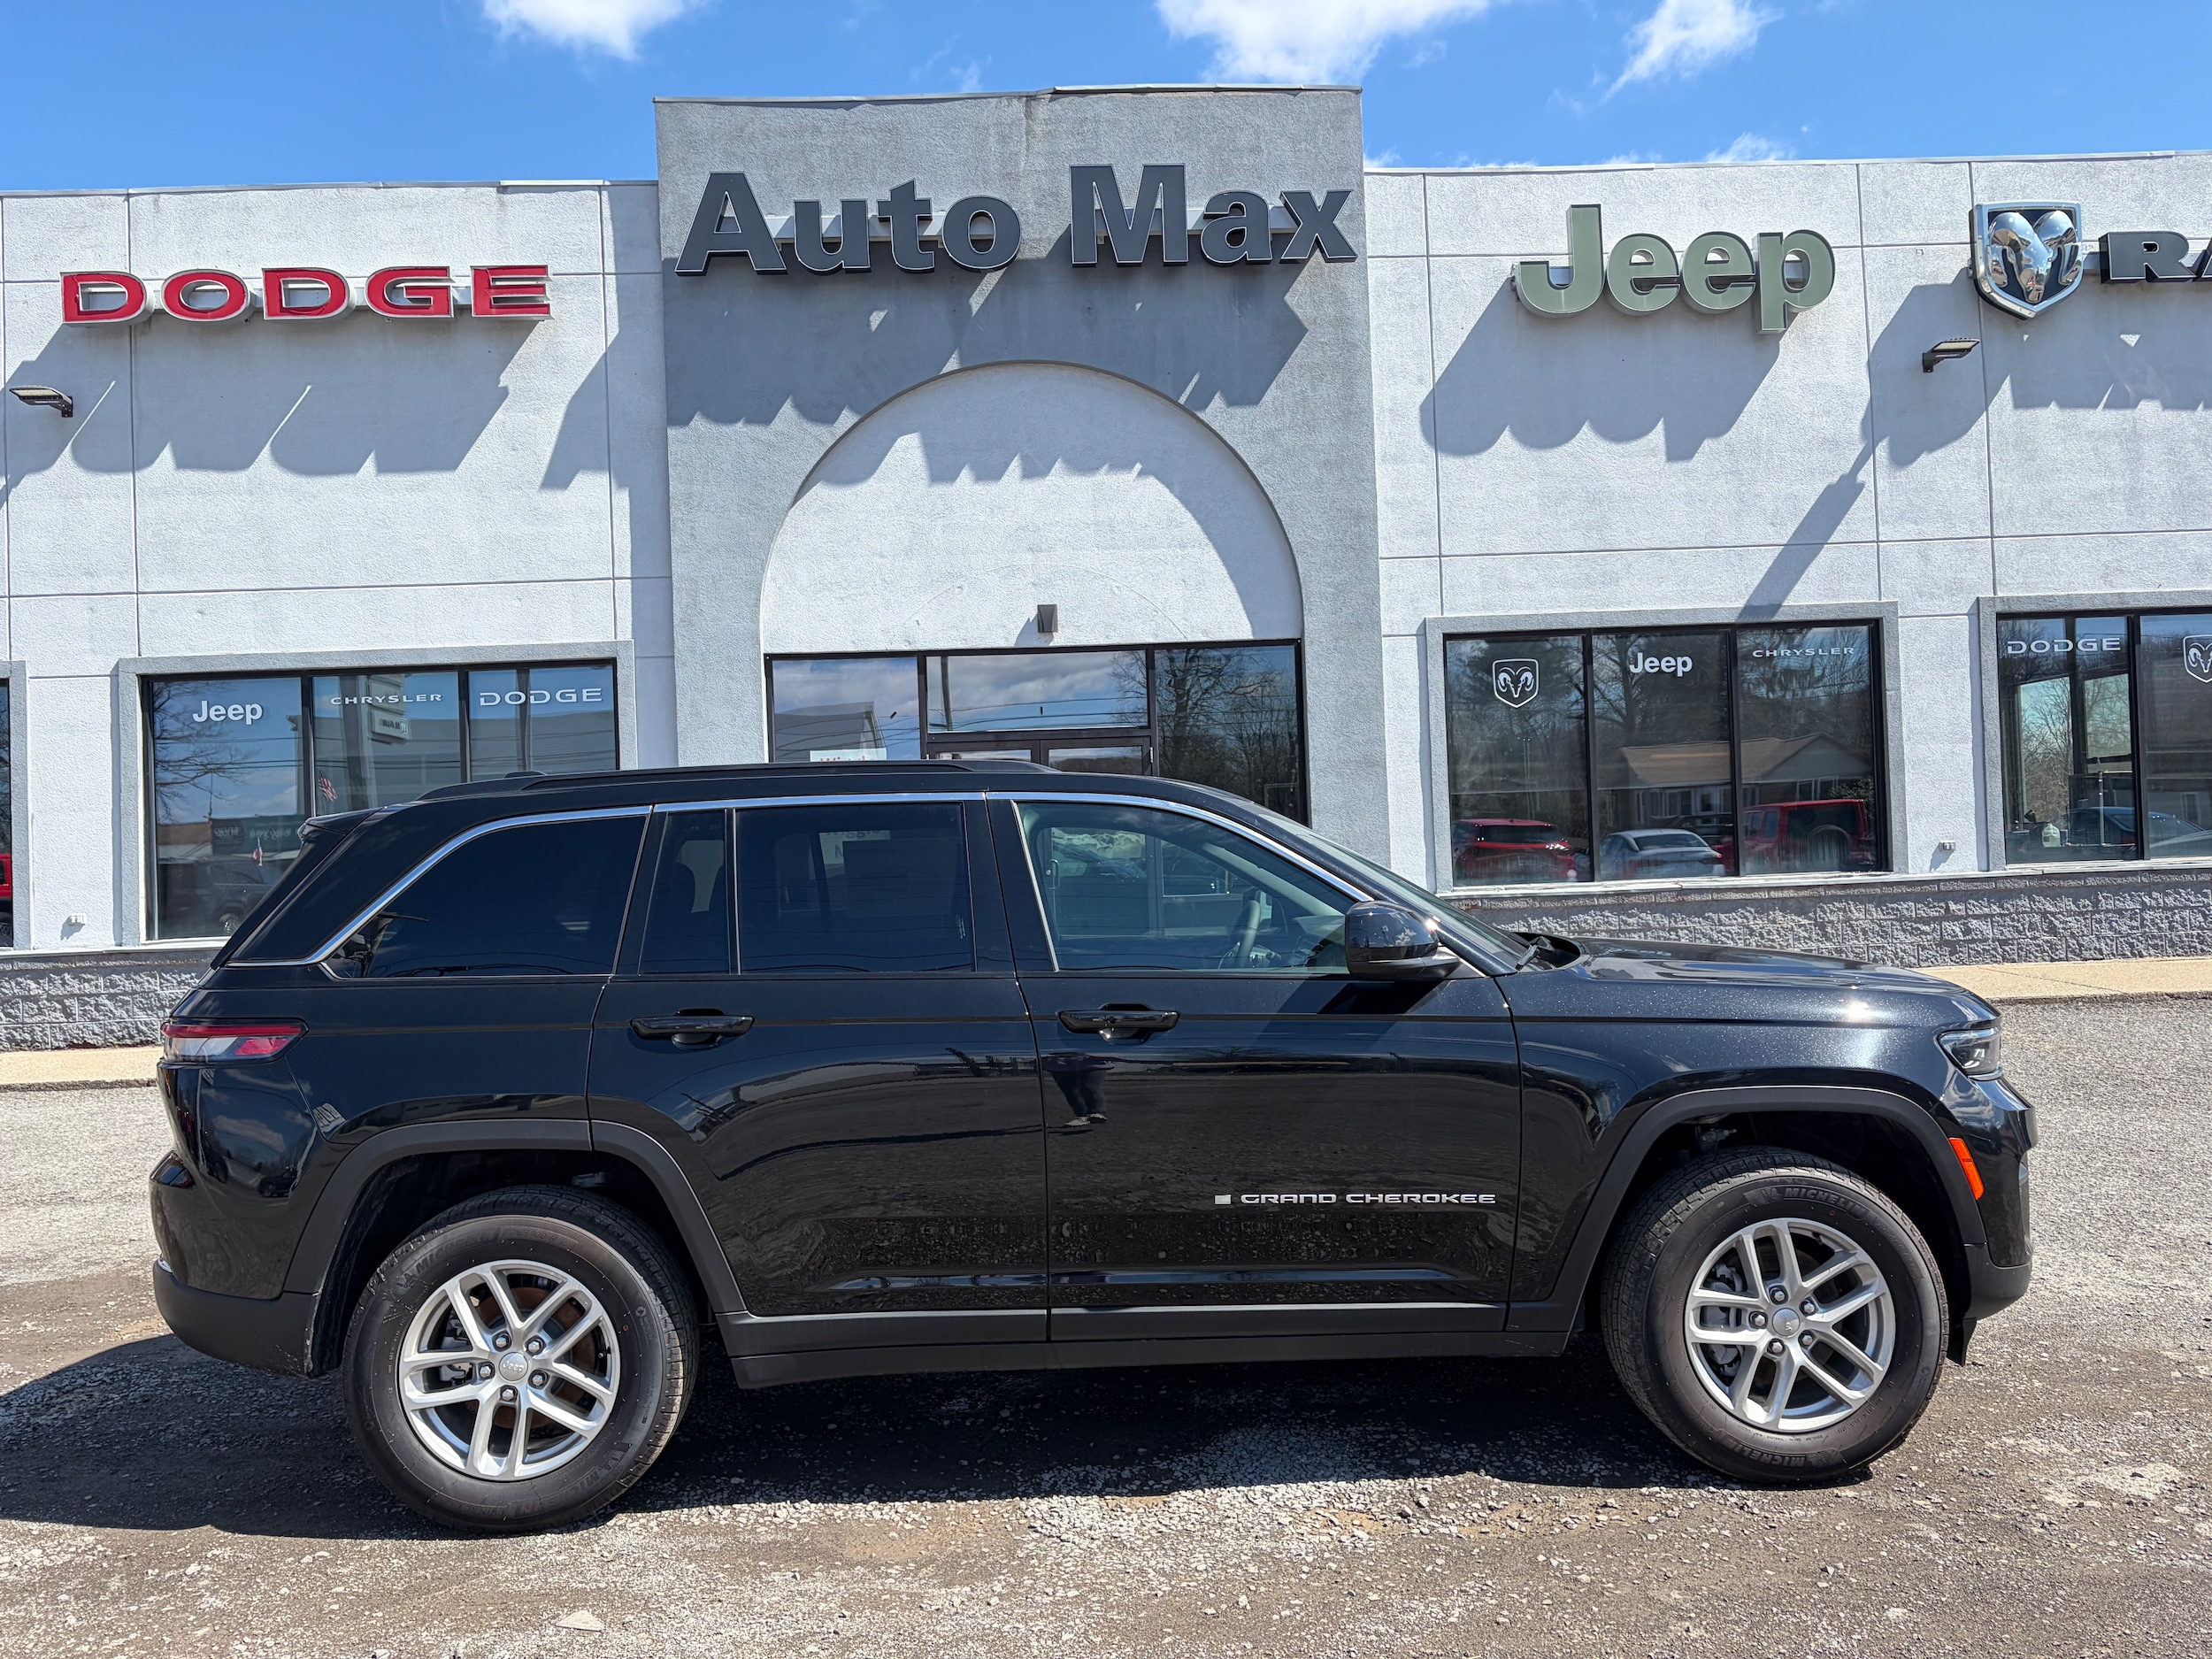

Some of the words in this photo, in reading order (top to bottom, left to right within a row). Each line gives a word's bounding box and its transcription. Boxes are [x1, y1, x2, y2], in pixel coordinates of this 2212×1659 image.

[675, 172, 1022, 275] Auto
[1069, 162, 1359, 267] Max
[1515, 204, 1836, 334] Jeep
[2099, 230, 2212, 283] R
[60, 265, 553, 326] DODGE
[1752, 646, 1855, 659] CHRYSLER
[2007, 637, 2122, 655] DODGE
[1629, 652, 1694, 678] Jeep
[330, 692, 444, 706] CHRYSLER
[479, 687, 603, 707] DODGE
[192, 699, 263, 726] Jeep
[1240, 1193, 1338, 1204] GRAND
[1345, 1193, 1496, 1204] CHEROKEE
[1784, 1187, 1867, 1219] MICHELIN
[416, 1228, 499, 1274] MICHELIN
[503, 1360, 525, 1372] Jeep
[1722, 1437, 1806, 1467] MICHELIN
